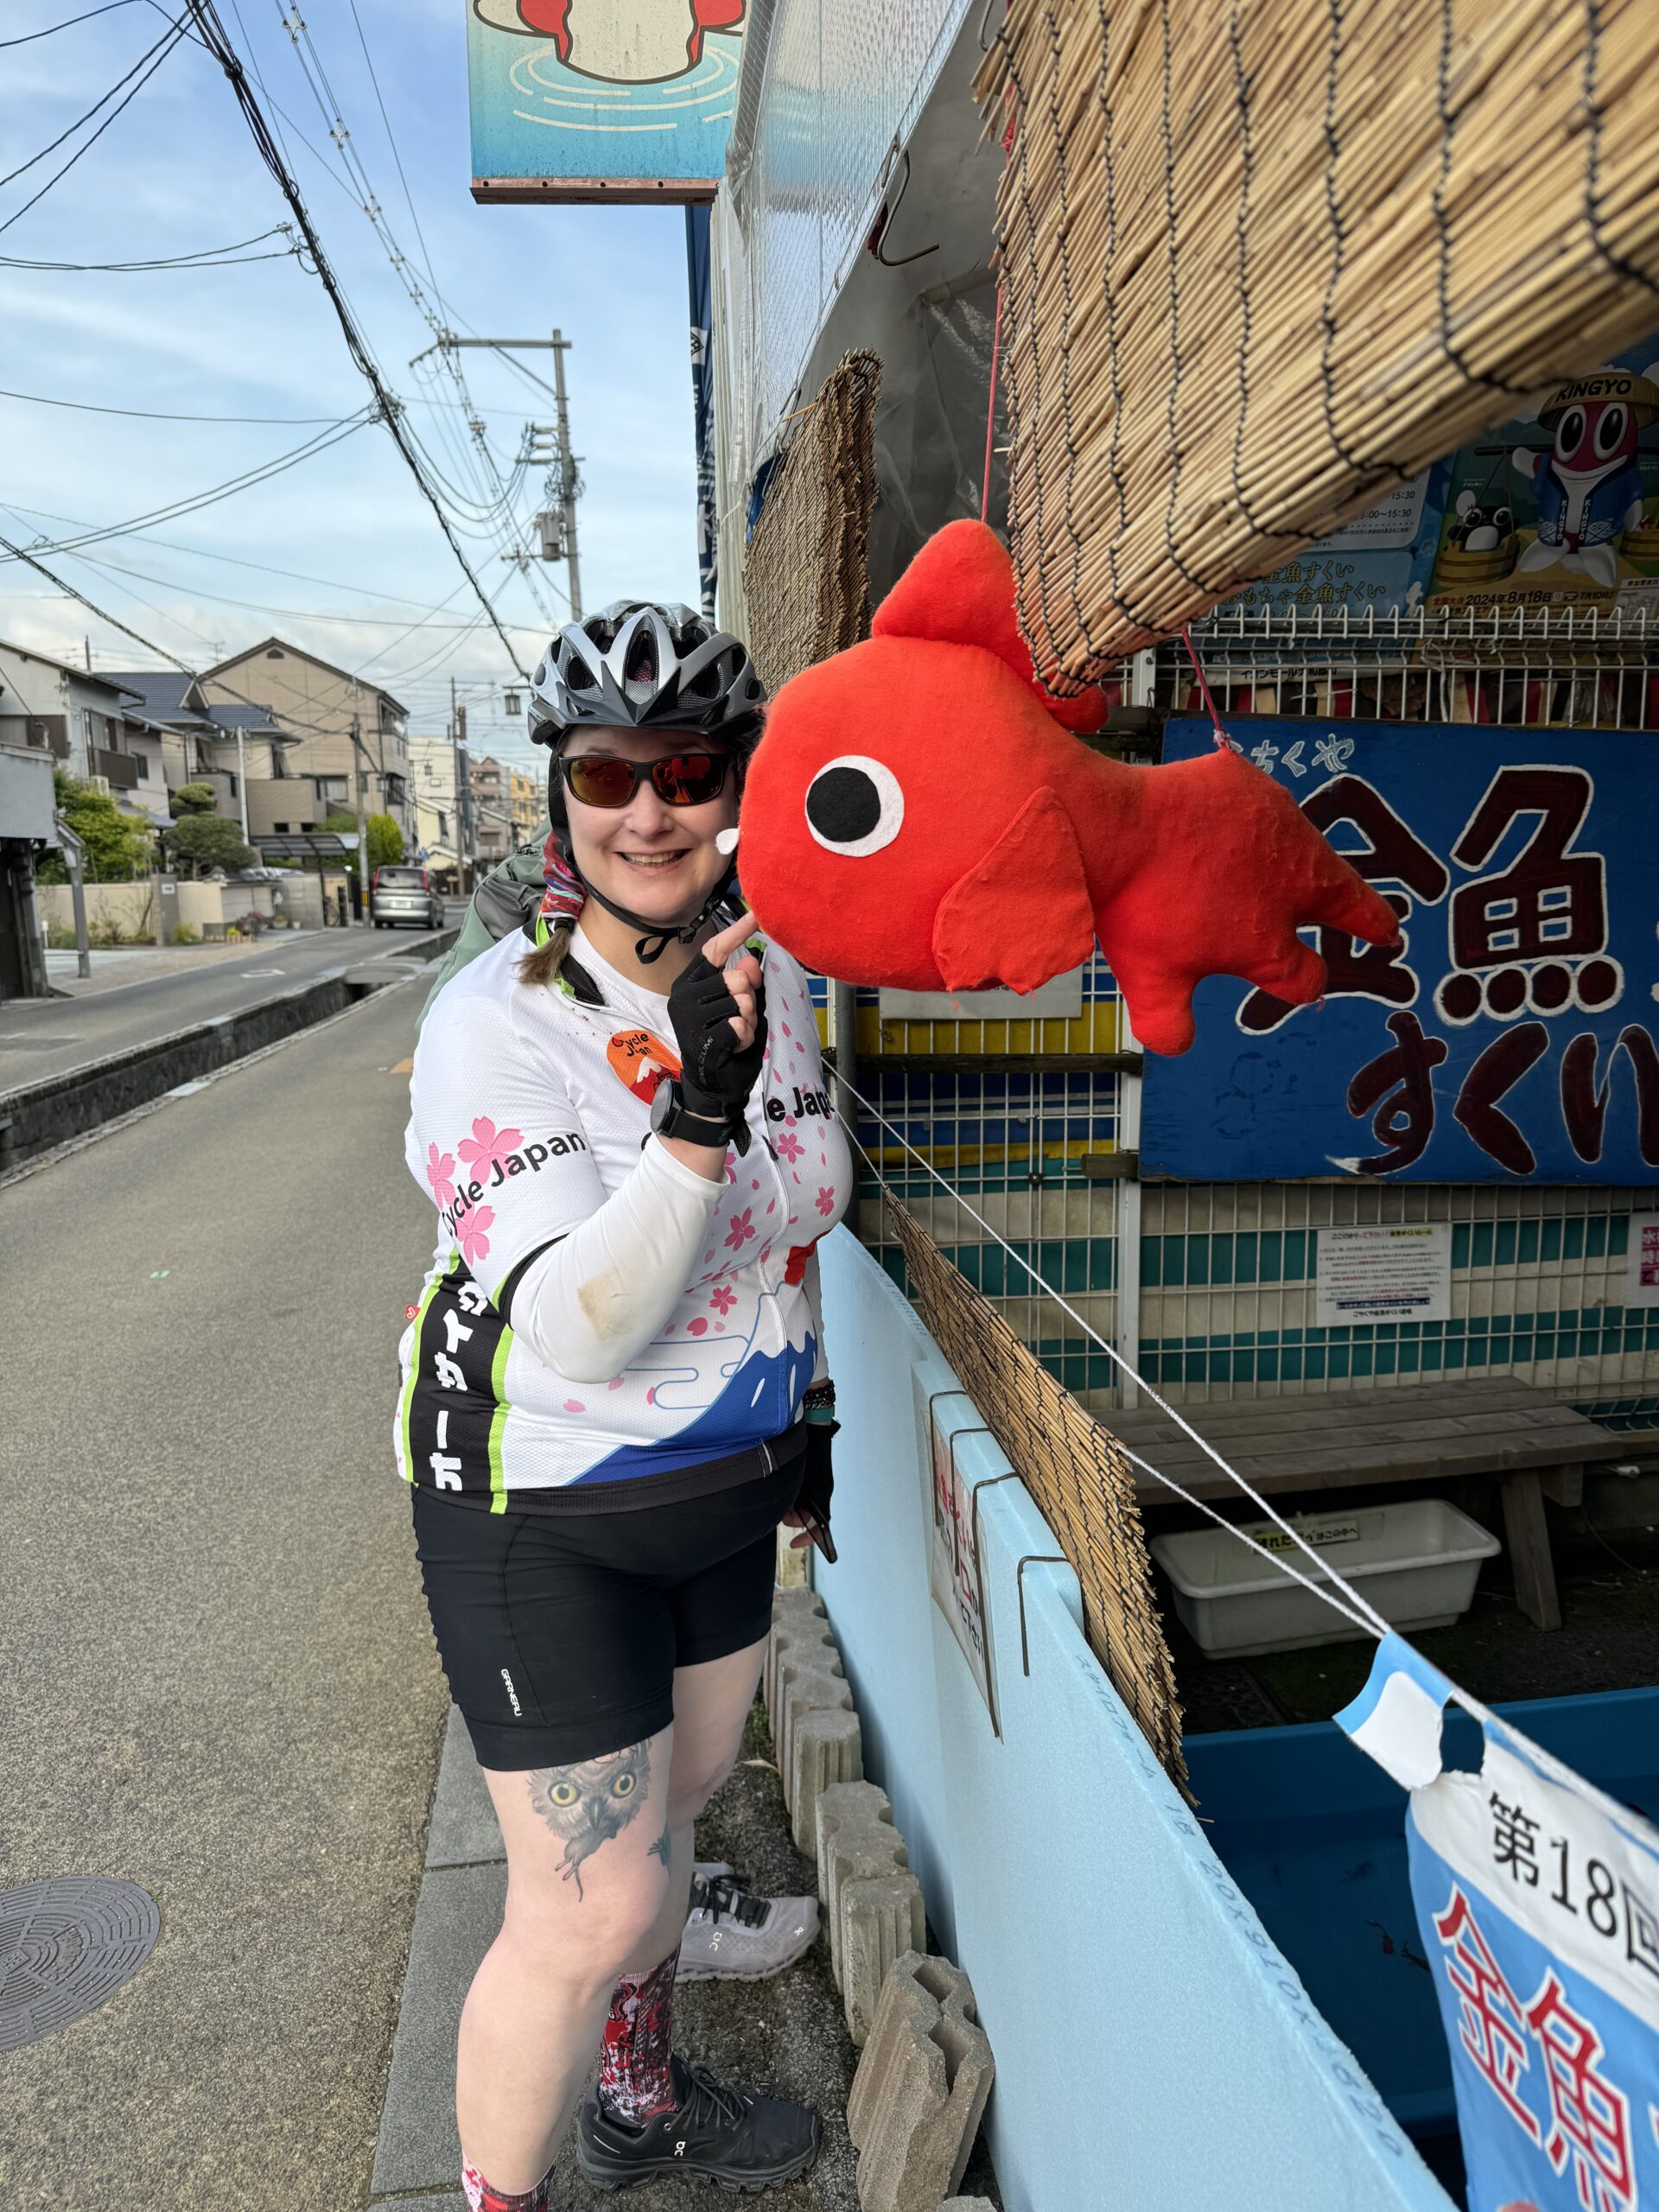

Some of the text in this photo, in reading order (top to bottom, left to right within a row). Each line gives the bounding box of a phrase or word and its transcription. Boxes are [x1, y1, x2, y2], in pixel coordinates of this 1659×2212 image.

[1556, 378, 1631, 403] KINGYO
[1556, 499, 1569, 542] KINGYO
[1578, 498, 1592, 542] KINGYO
[1325, 1009, 1659, 1176] すくい
[491, 1133, 587, 1187] Japan
[500, 1668, 523, 1717] GARNEAU
[1489, 1790, 1659, 1979] 第18回
[1432, 1880, 1638, 2212] 金魚
